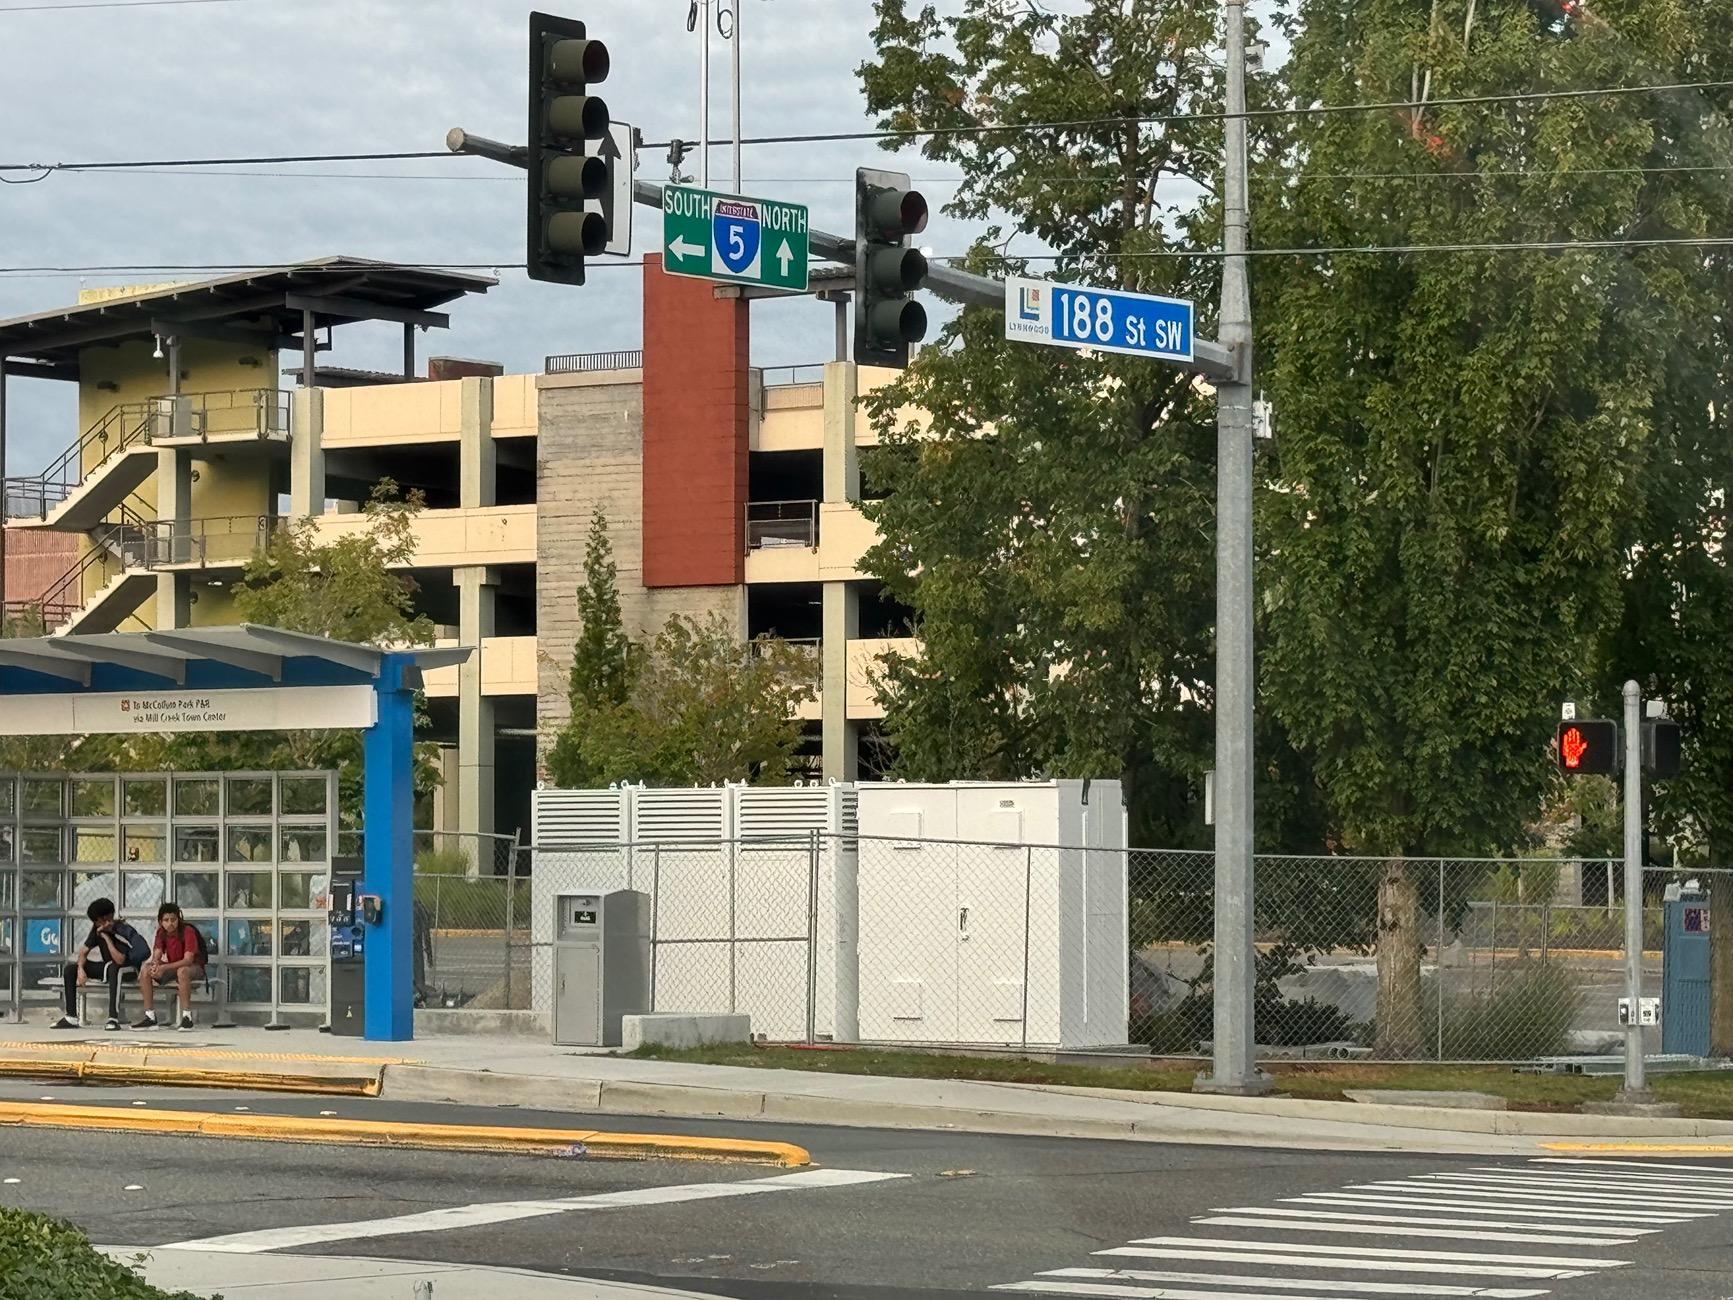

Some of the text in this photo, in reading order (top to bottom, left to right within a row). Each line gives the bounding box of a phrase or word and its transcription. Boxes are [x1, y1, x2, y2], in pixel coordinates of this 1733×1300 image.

[665, 190, 710, 220] SOUTH
[762, 204, 806, 233] NORTH
[728, 225, 745, 261] 5
[1060, 293, 1182, 350] 188 St SW
[133, 700, 140, 710] To
[178, 699, 194, 709] Park
[195, 699, 210, 708] P&R
[133, 711, 226, 723] via Mill Creek Town Center
